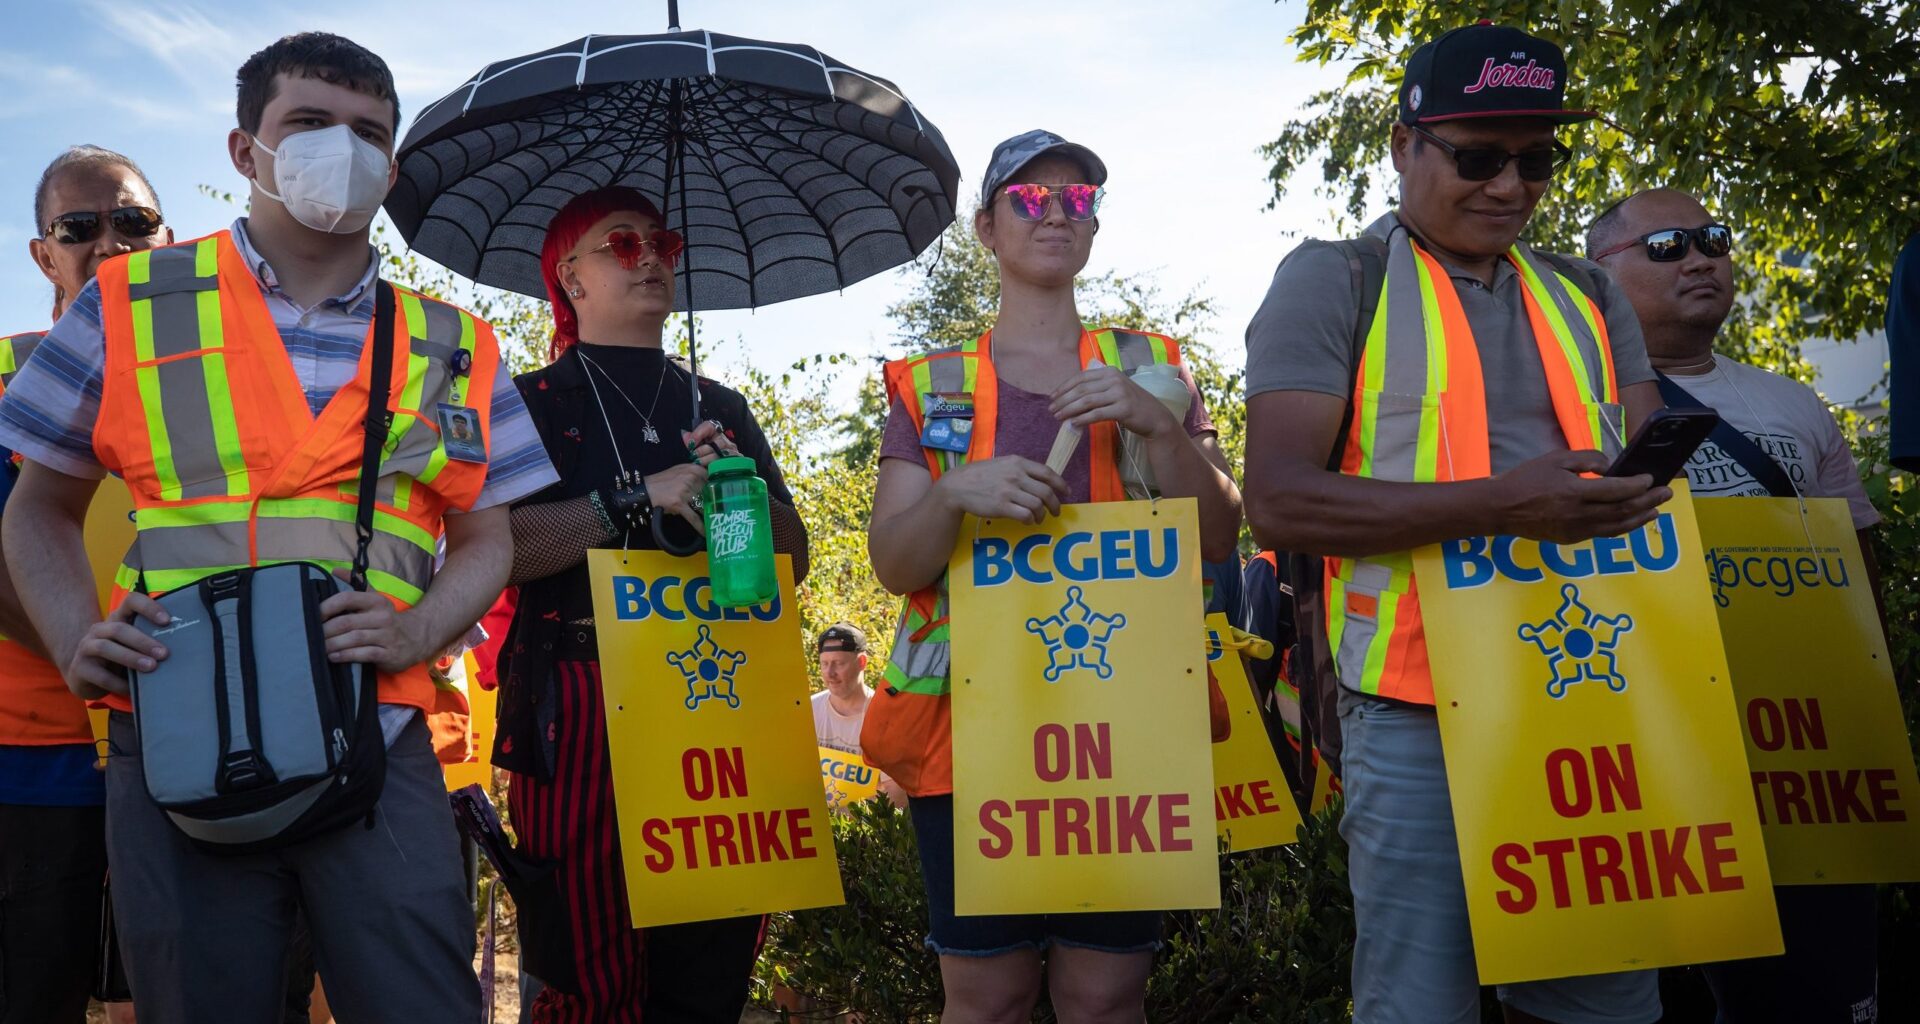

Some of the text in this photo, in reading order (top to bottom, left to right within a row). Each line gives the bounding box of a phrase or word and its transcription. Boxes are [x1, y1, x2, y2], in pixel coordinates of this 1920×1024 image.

[1464, 57, 1555, 93] Jordan
[1510, 51, 1525, 60] AIR
[934, 403, 965, 412] bcgeu
[1691, 461, 1750, 486] FITC
[709, 509, 756, 530] ZOMBIE
[715, 535, 748, 558] CLUB
[972, 526, 1181, 588] BCGEU
[1710, 548, 1850, 597] bcgeu
[1745, 696, 1828, 752] ON
[680, 745, 750, 803] ON
[820, 758, 873, 785] CGEU
[1034, 723, 1113, 783] ON
[1215, 779, 1281, 821] IKE
[1544, 743, 1643, 819] ON
[1750, 769, 1907, 826] TRIKE
[640, 806, 819, 875] STRIKE
[978, 793, 1194, 860] STRIKE
[1490, 821, 1746, 916] STRIKE
